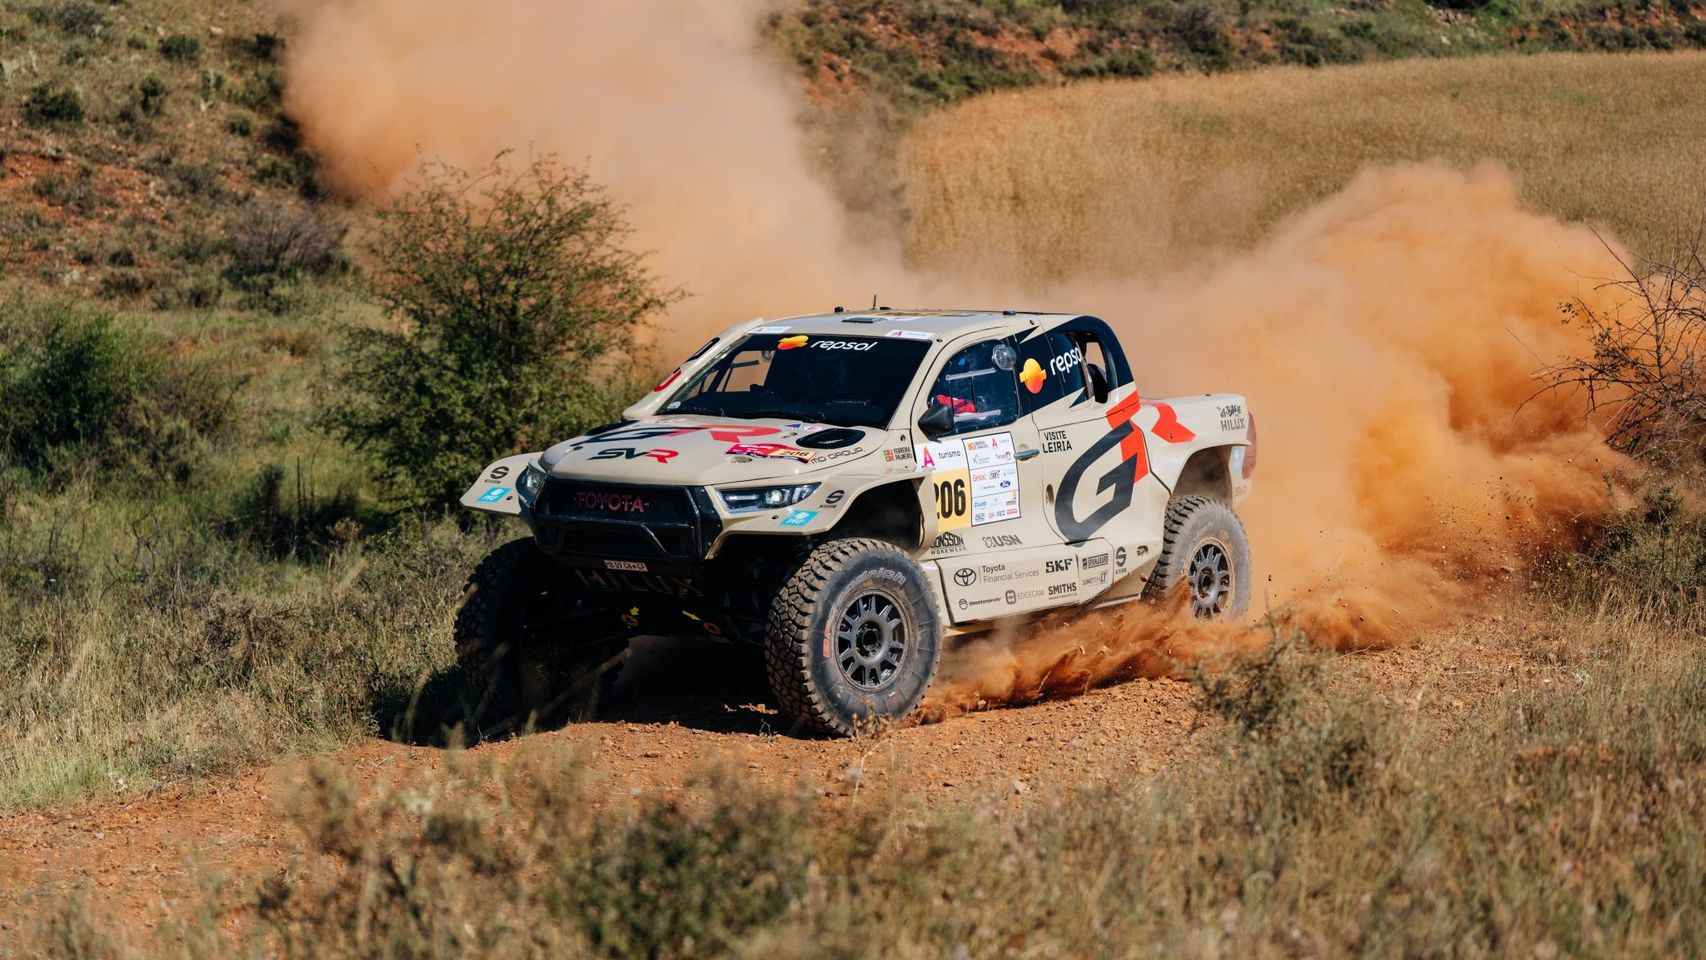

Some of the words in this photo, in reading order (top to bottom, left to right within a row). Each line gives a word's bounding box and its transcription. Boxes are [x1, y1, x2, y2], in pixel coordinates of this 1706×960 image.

[811, 340, 878, 351] repsol
[1050, 346, 1082, 376] repso
[1220, 417, 1246, 432] HILUX
[1044, 430, 1067, 441] VISITE
[828, 446, 864, 460] GROUP
[1042, 441, 1073, 454] LEIRIA
[938, 450, 961, 460] turismo
[1055, 390, 1196, 547] GR
[576, 491, 645, 513] TOYOTA
[933, 479, 966, 520] 06
[992, 534, 1023, 548] USN
[930, 547, 967, 555] WORKWEAR
[982, 563, 1006, 574] Toyota
[1045, 558, 1073, 574] SKF
[983, 572, 1013, 584] Financial
[1015, 569, 1040, 580] Services
[1017, 589, 1045, 600] EDGECAM
[1048, 582, 1077, 596] SMITHS
